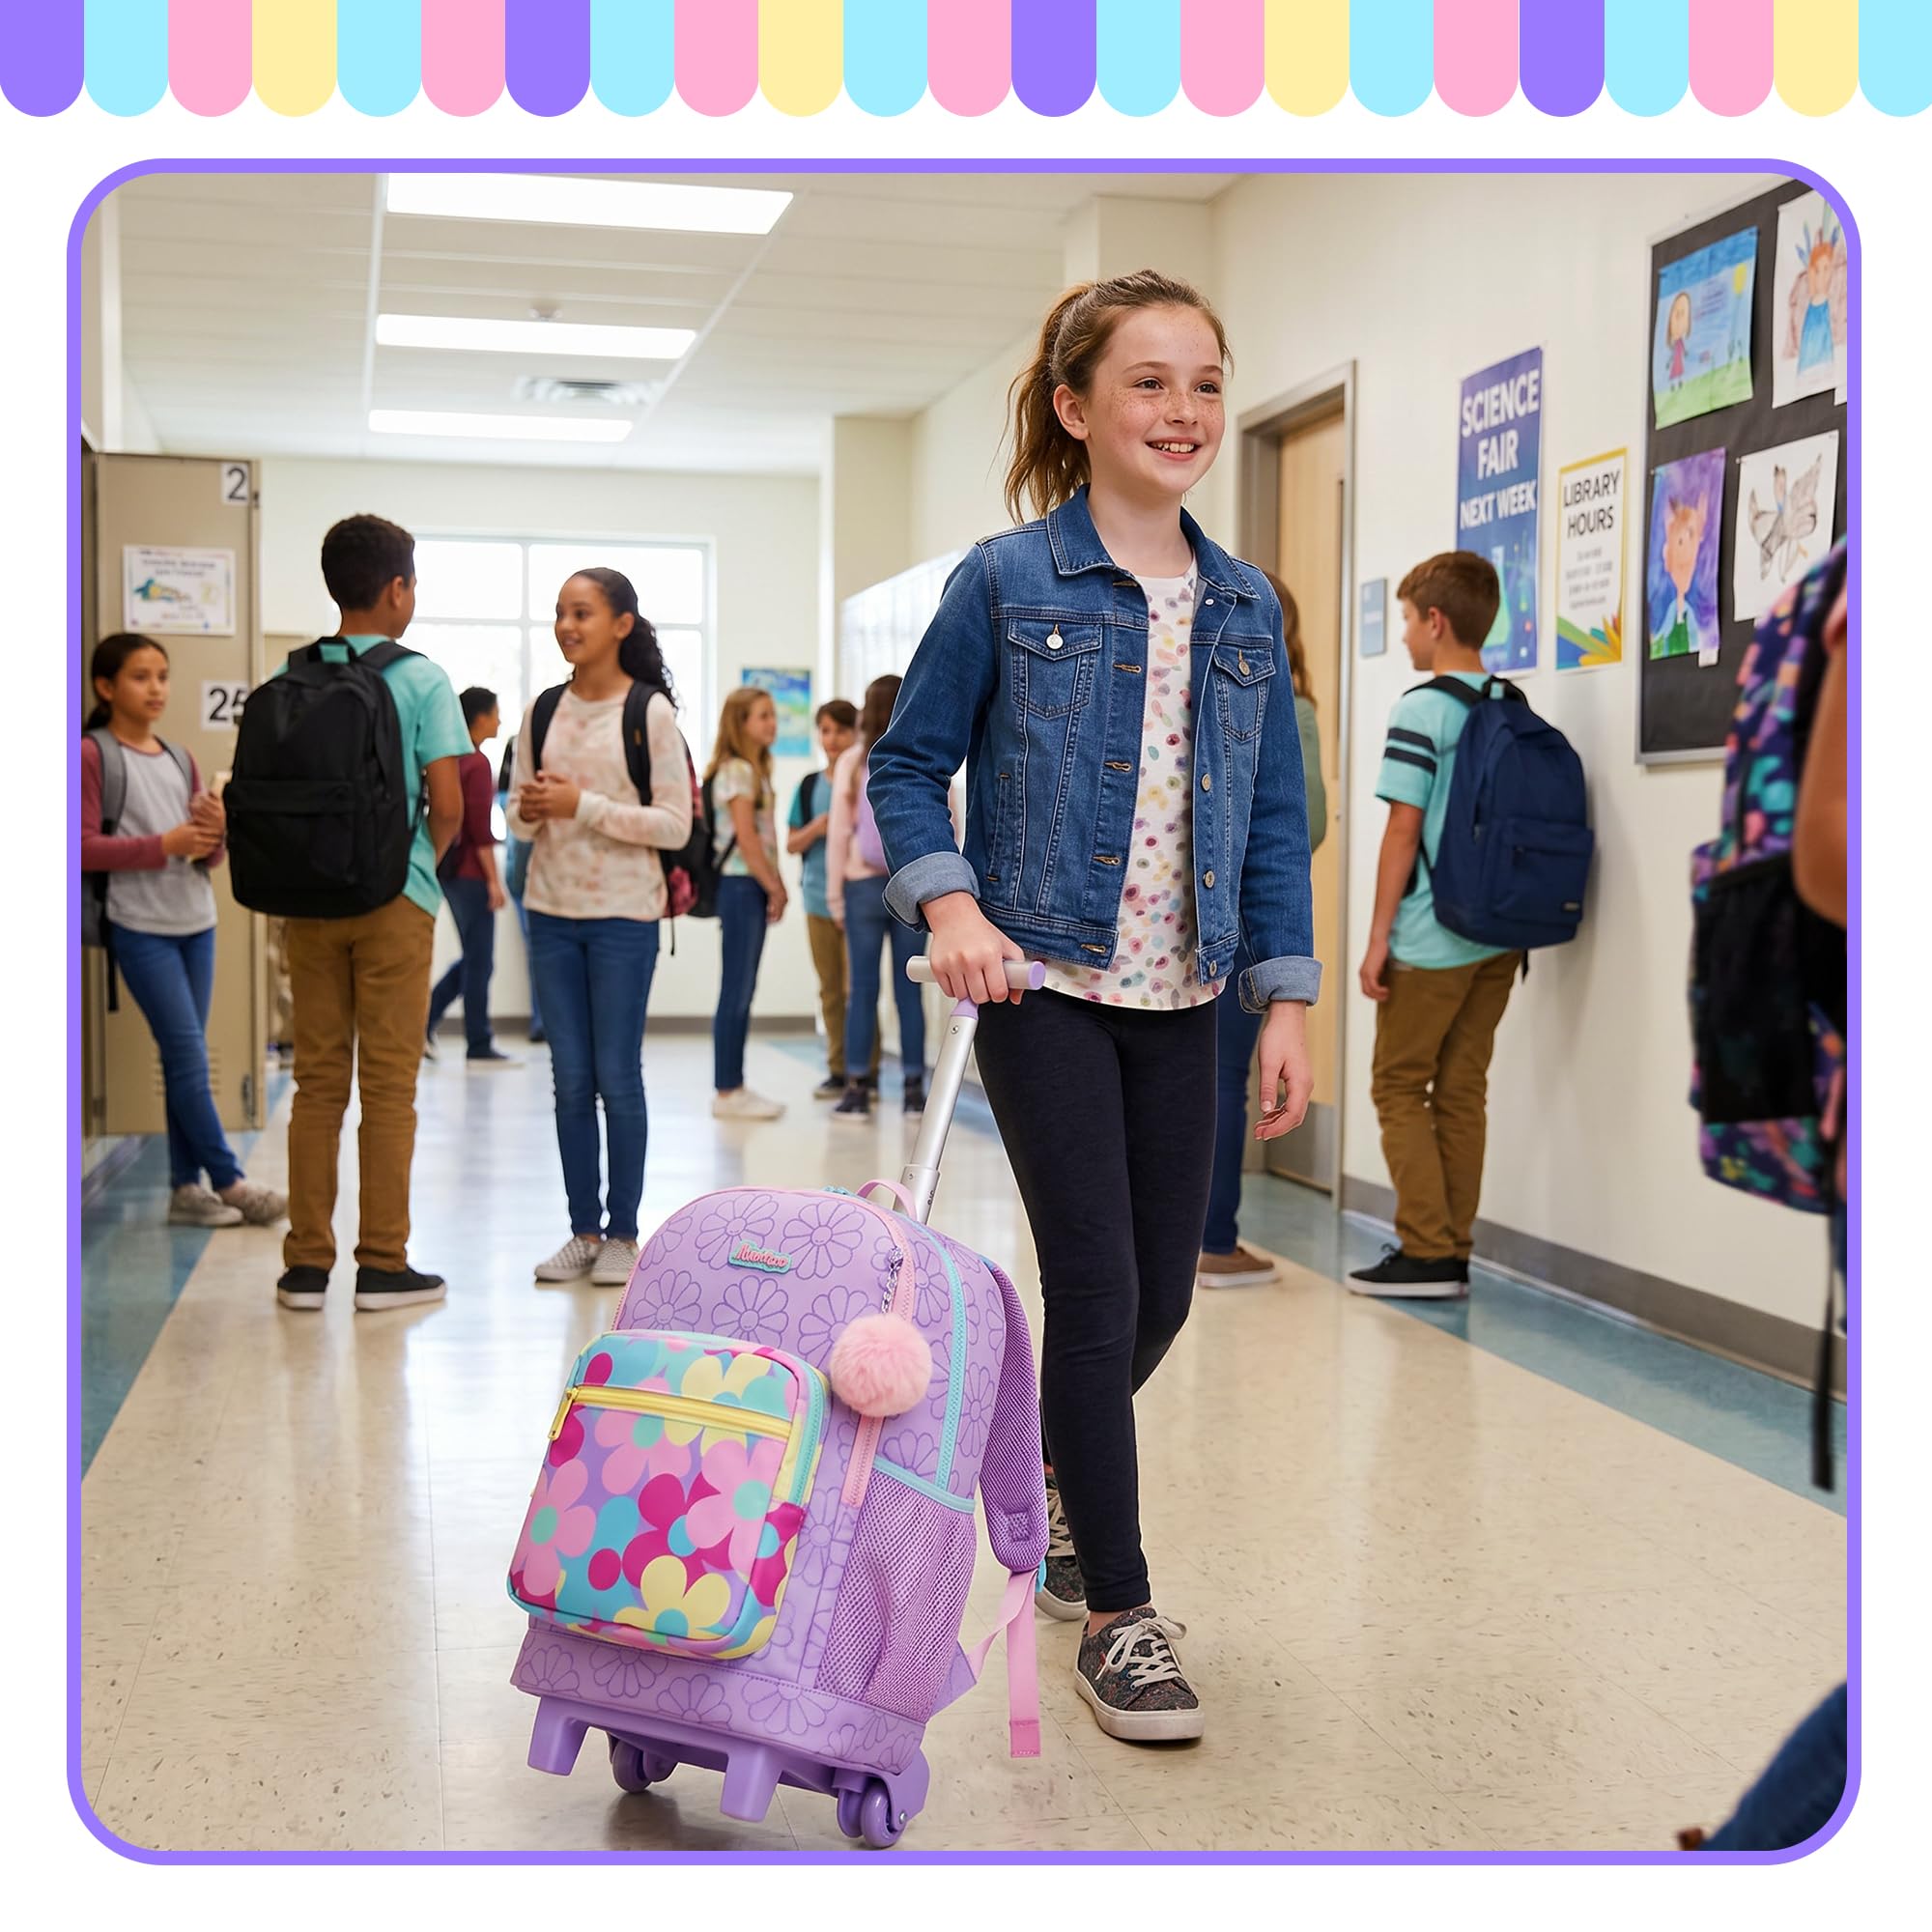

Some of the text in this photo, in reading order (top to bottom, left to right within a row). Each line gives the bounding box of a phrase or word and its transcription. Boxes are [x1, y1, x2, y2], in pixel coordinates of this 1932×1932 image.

[1462, 369, 1540, 439] SCIENCE
[1478, 429, 1519, 480] FAIR
[1460, 479, 1537, 529] NEXT WEEK
[1563, 469, 1620, 507] LIBRARY
[1567, 504, 1614, 539] HOURS
